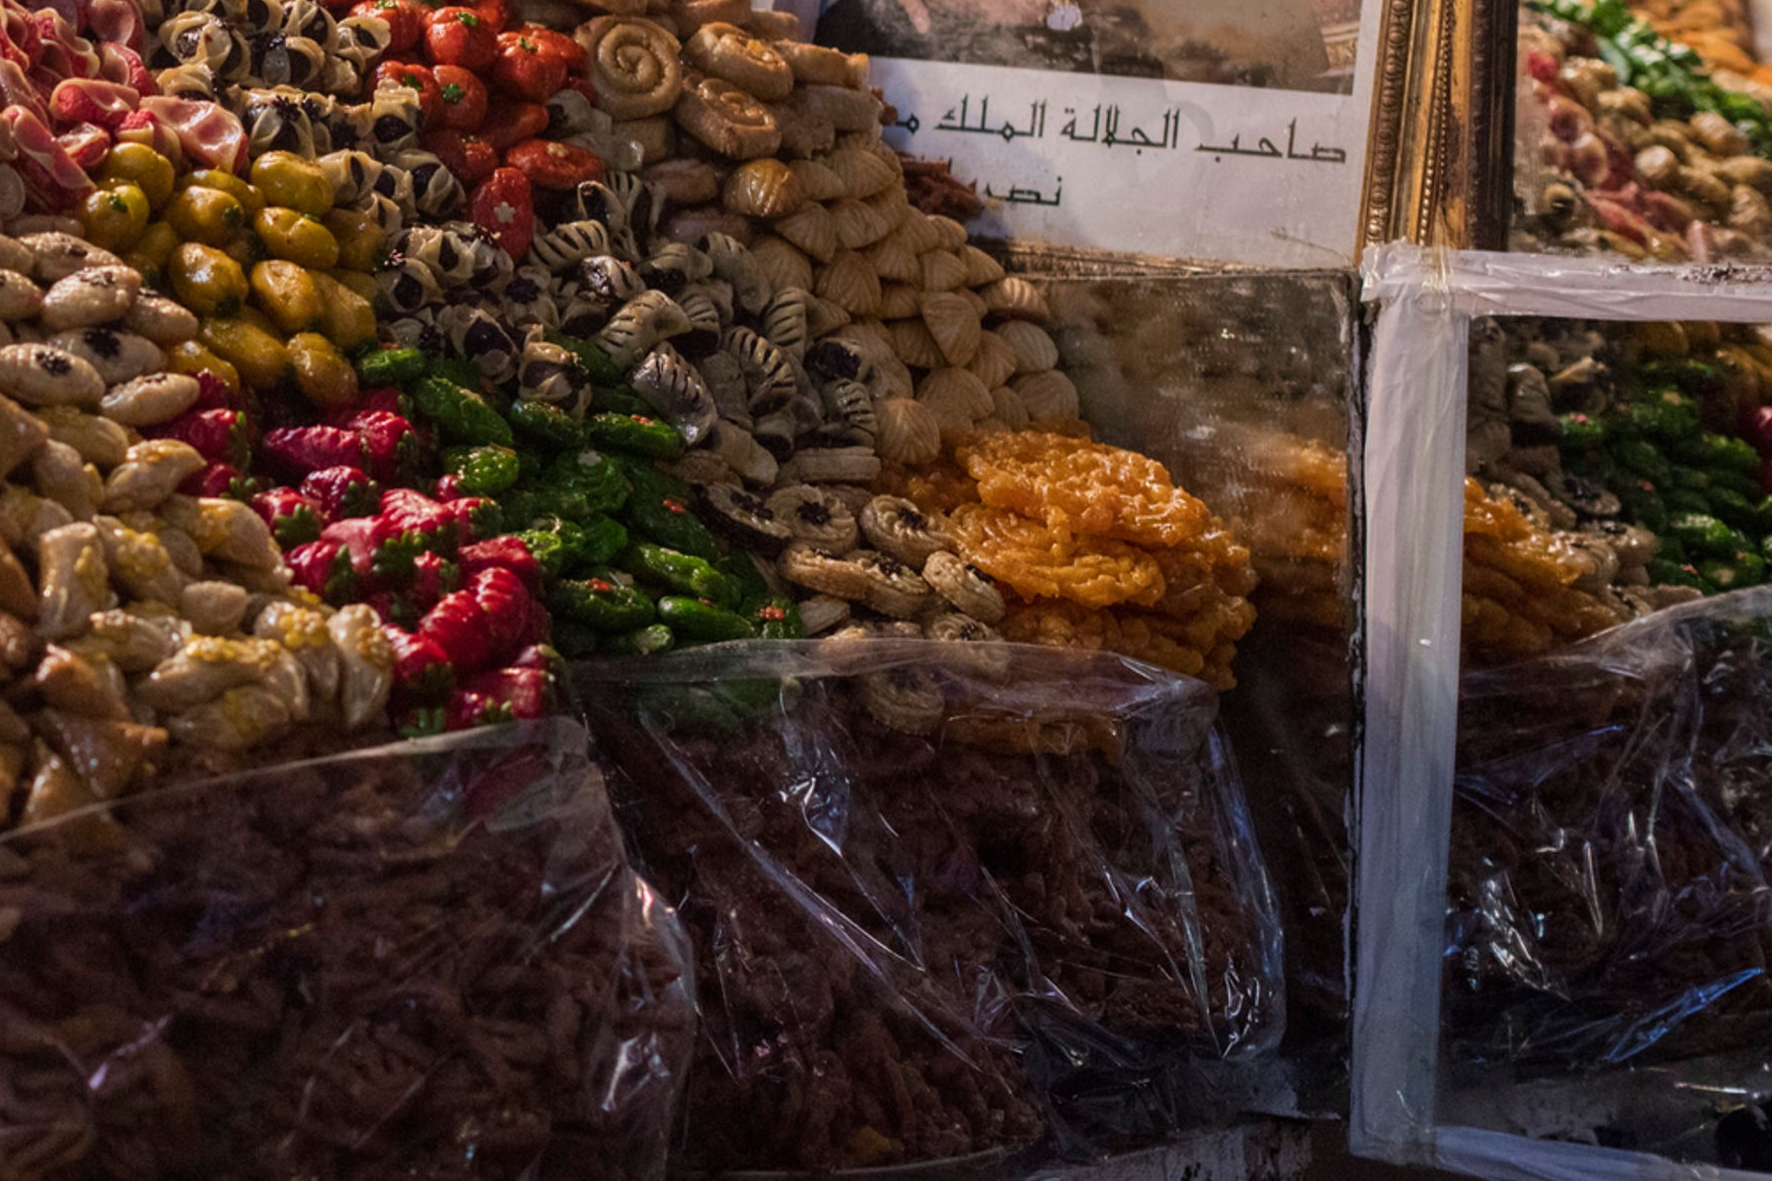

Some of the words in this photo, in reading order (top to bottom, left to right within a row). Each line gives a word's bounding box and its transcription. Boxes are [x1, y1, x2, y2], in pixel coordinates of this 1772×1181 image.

[934, 94, 1047, 144] الملك
[1060, 103, 1180, 156] الجلالة
[1193, 117, 1347, 163] صاحب
